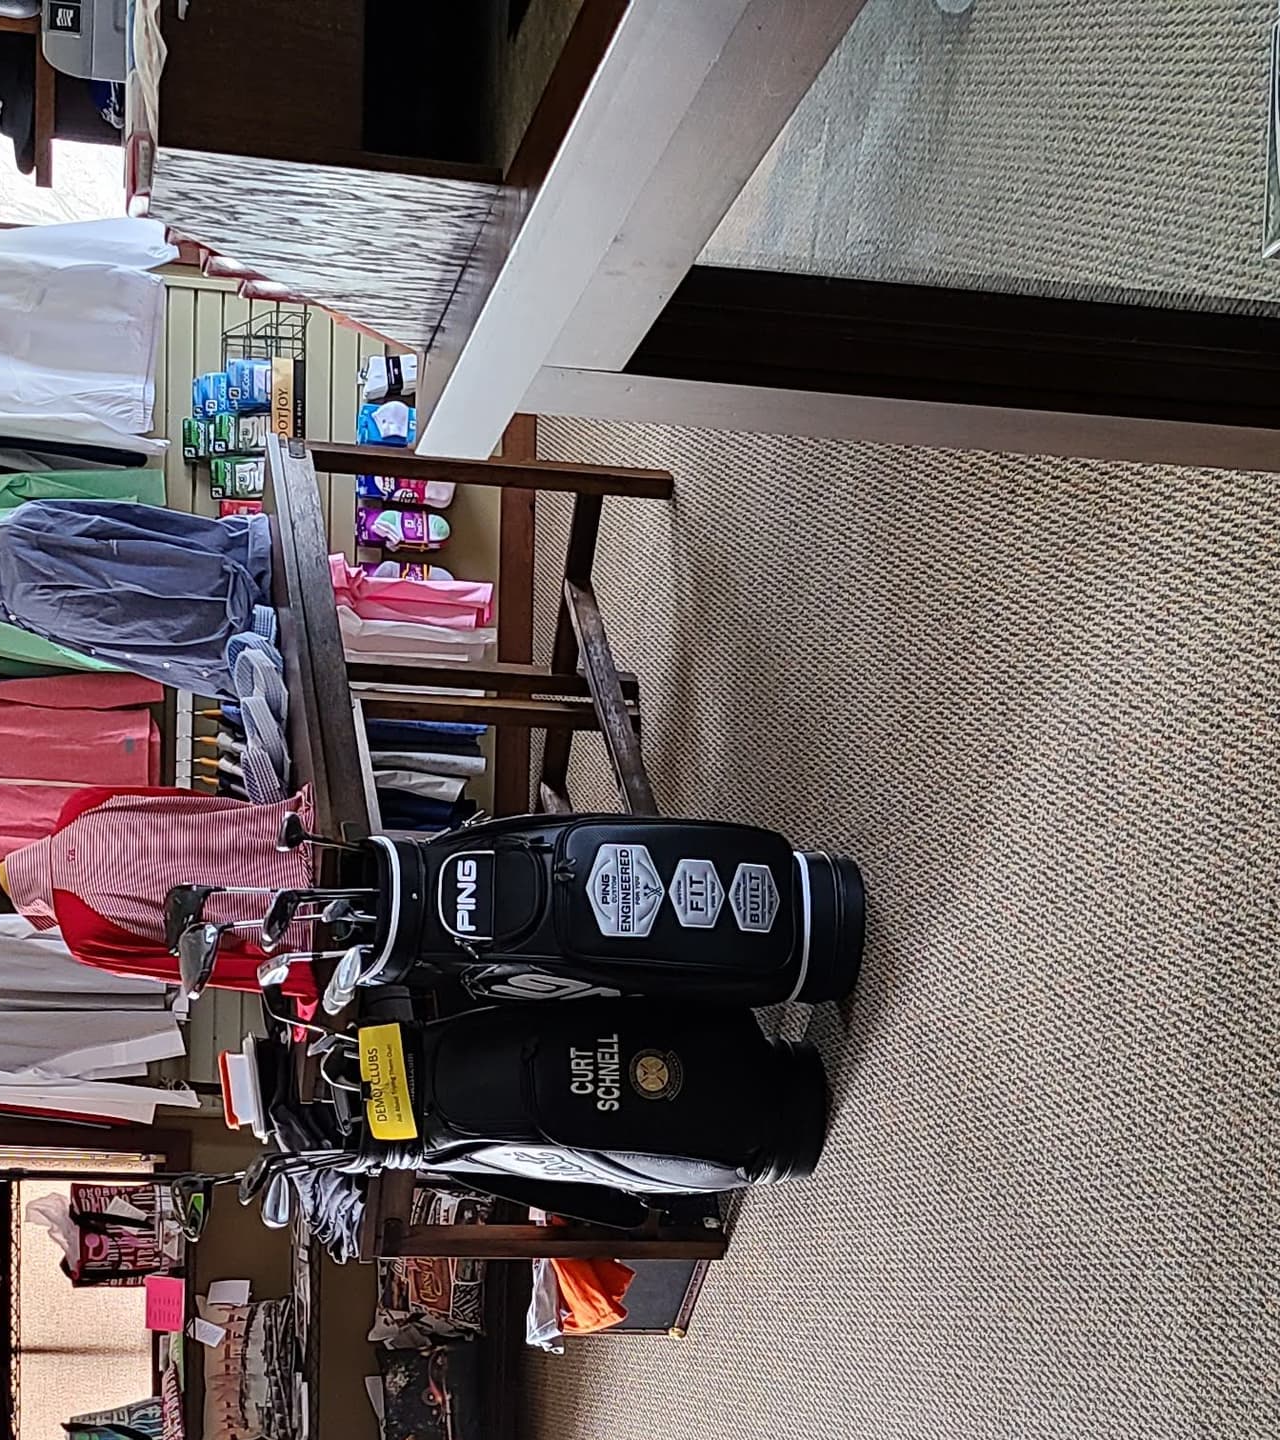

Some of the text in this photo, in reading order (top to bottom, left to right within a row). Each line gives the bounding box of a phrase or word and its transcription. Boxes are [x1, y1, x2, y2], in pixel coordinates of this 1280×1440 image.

[457, 860, 477, 930] PING
[601, 874, 610, 905] PING
[619, 849, 631, 932] ENGINEERED
[689, 875, 705, 912] FIT
[749, 872, 760, 924] BUILT
[367, 1048, 388, 1122] DEMO CLUBS
[570, 1047, 594, 1094] CURT
[596, 1033, 620, 1111] SCHNELL
